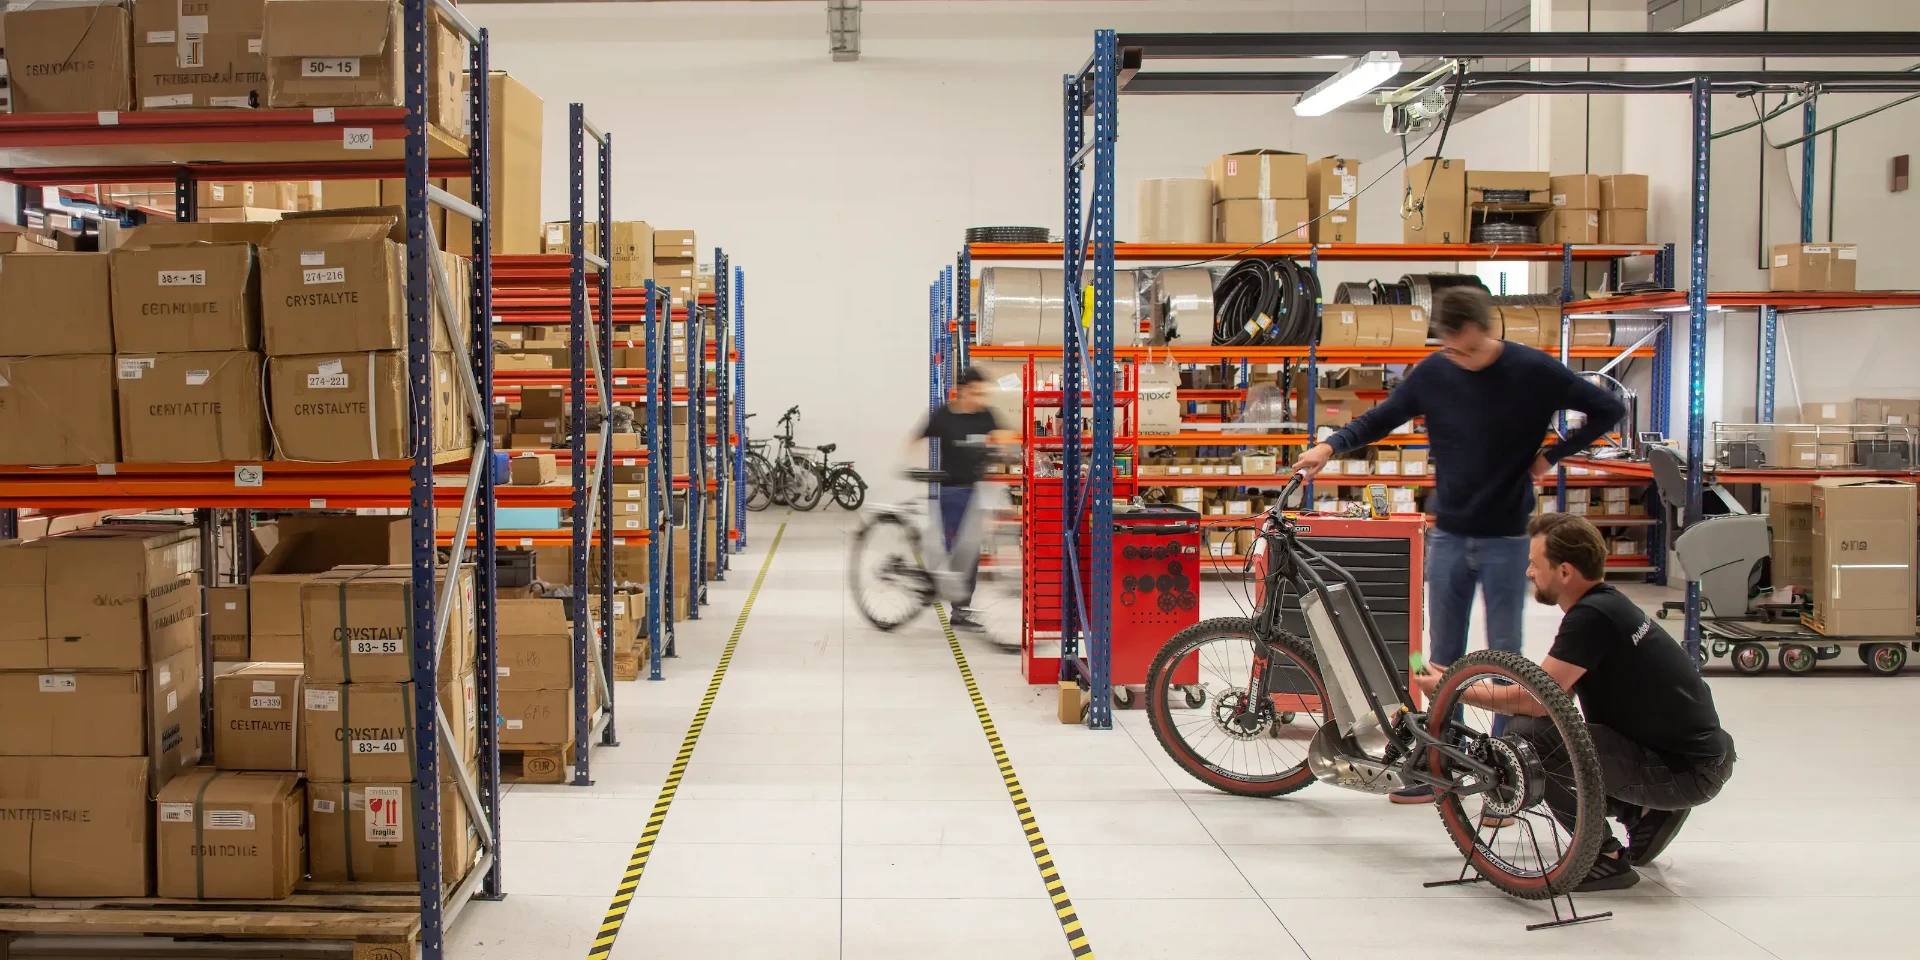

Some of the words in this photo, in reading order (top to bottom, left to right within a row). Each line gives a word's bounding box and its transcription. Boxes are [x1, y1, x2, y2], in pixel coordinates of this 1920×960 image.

[337, 62, 352, 73] 15
[348, 133, 370, 145] 3080
[305, 271, 343, 282] 274-216
[285, 291, 359, 308] CRYSTALYTE
[309, 377, 346, 386] 274-221
[294, 402, 366, 416] CRYSTALYTE
[382, 642, 396, 652] 55
[383, 742, 397, 752] 40
[533, 760, 550, 772] EUR
[372, 828, 396, 837] fragile
